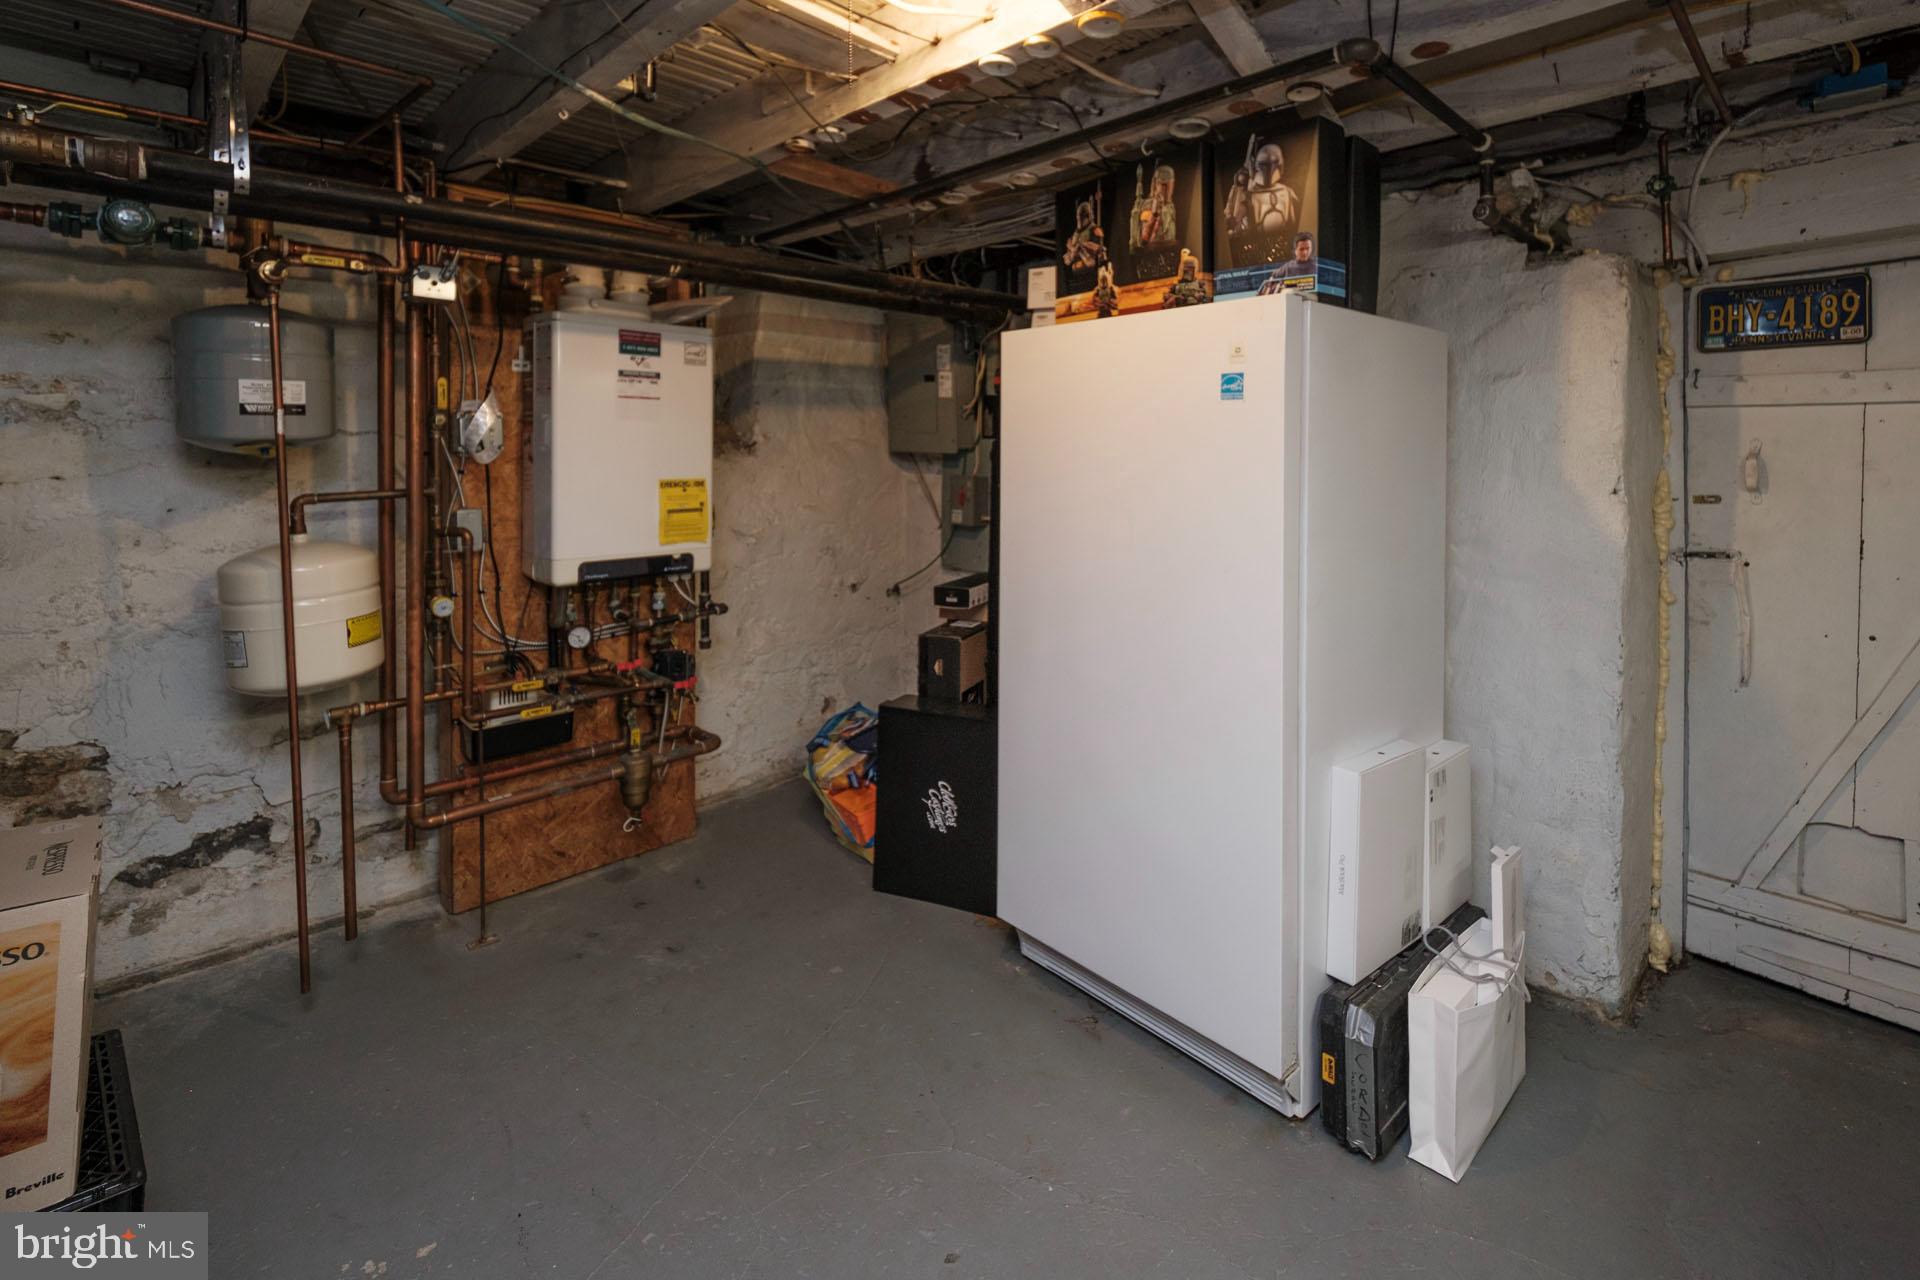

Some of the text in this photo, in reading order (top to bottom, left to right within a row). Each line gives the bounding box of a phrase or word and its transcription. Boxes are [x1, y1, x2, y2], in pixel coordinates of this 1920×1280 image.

[1708, 289, 1860, 336] BHY-4189
[1732, 331, 1826, 346] PENNSYLVANIA
[5, 1172, 65, 1199] Breville
